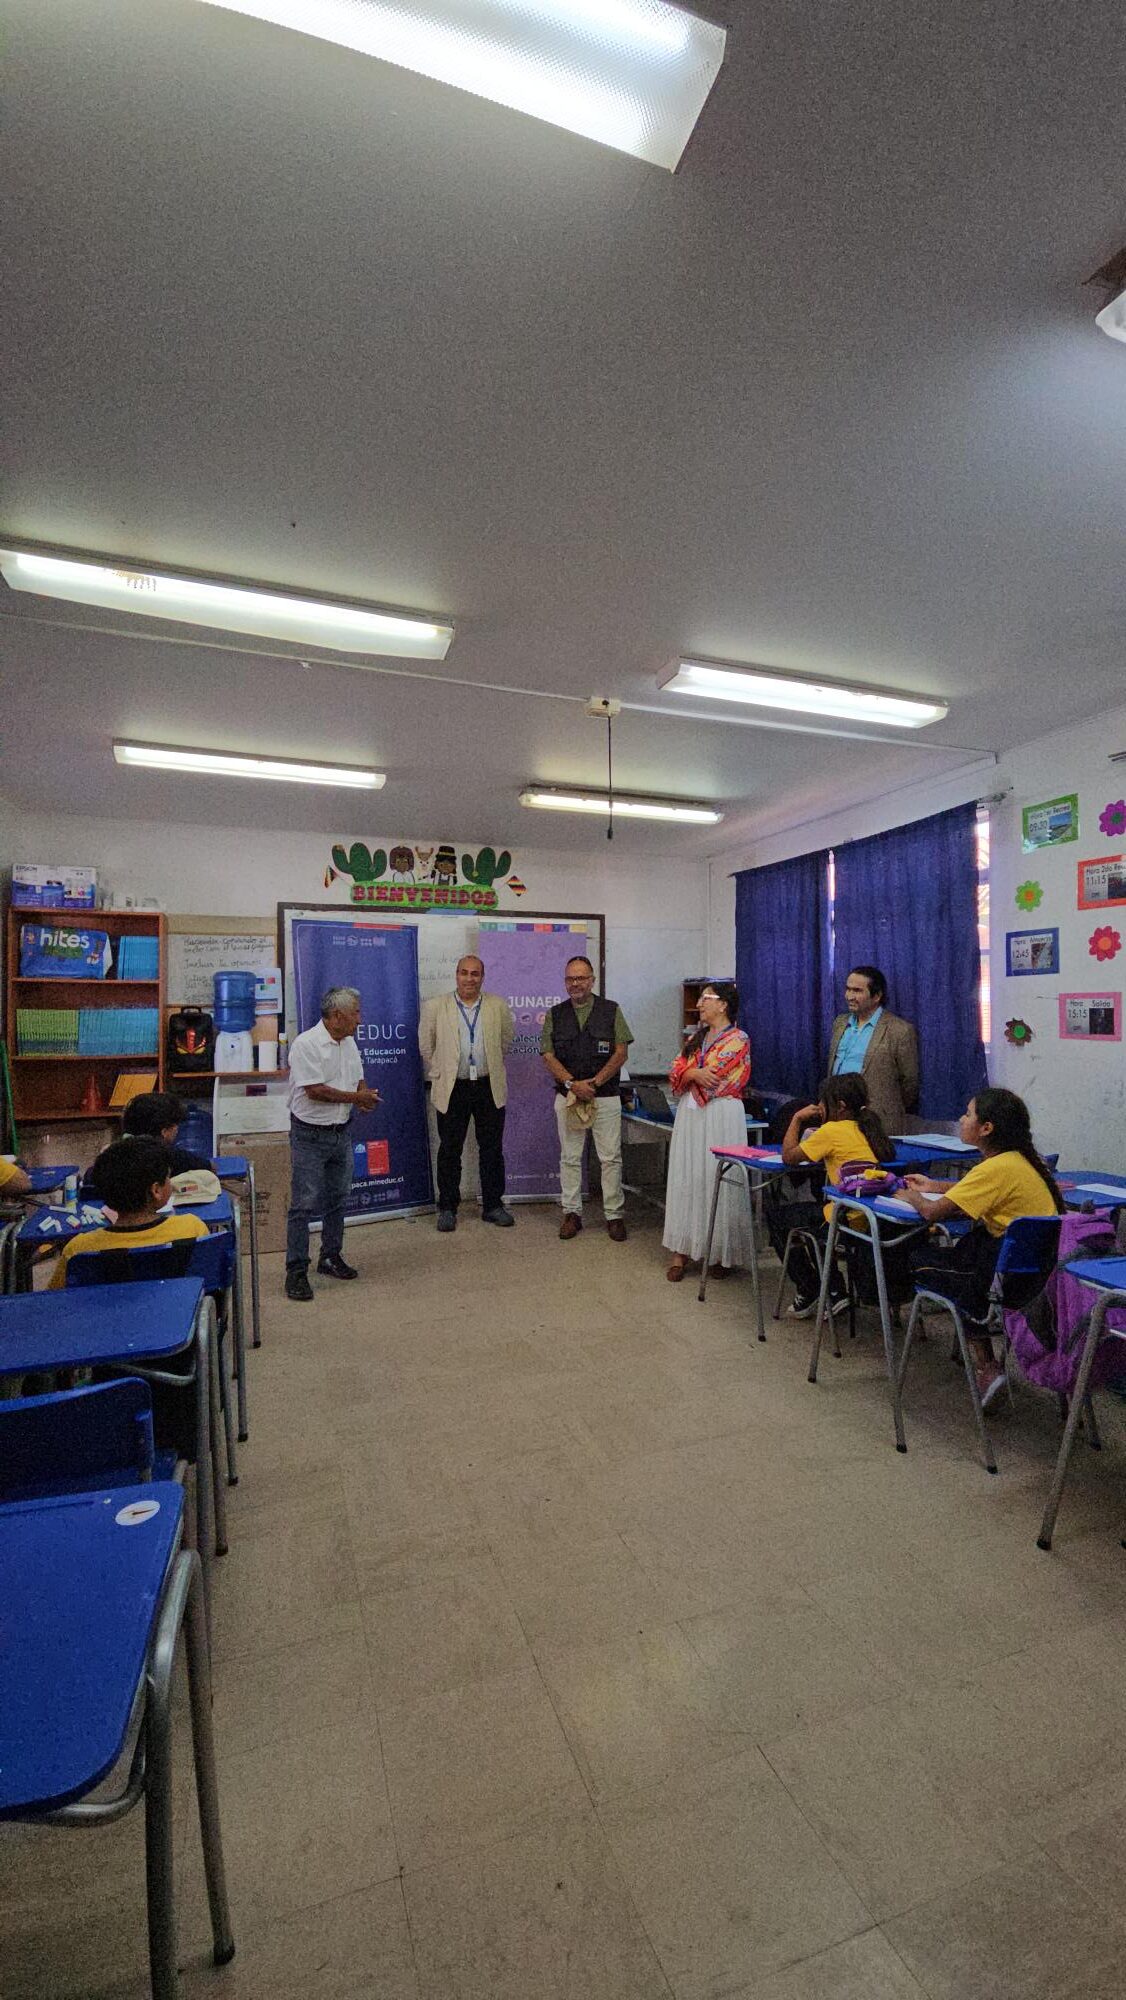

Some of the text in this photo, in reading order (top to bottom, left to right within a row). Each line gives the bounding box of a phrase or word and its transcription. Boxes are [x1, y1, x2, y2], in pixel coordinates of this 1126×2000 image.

[1086, 874, 1106, 886] 11:15
[352, 885, 497, 906] BIENVENIDOS
[40, 928, 89, 949] hites
[1091, 1000, 1111, 1008] Salida
[1068, 1009, 1087, 1019] 15:15
[356, 1024, 407, 1041] EDUC
[363, 1048, 407, 1056] Educación
[351, 1175, 404, 1189] paca.mineduc.cl
